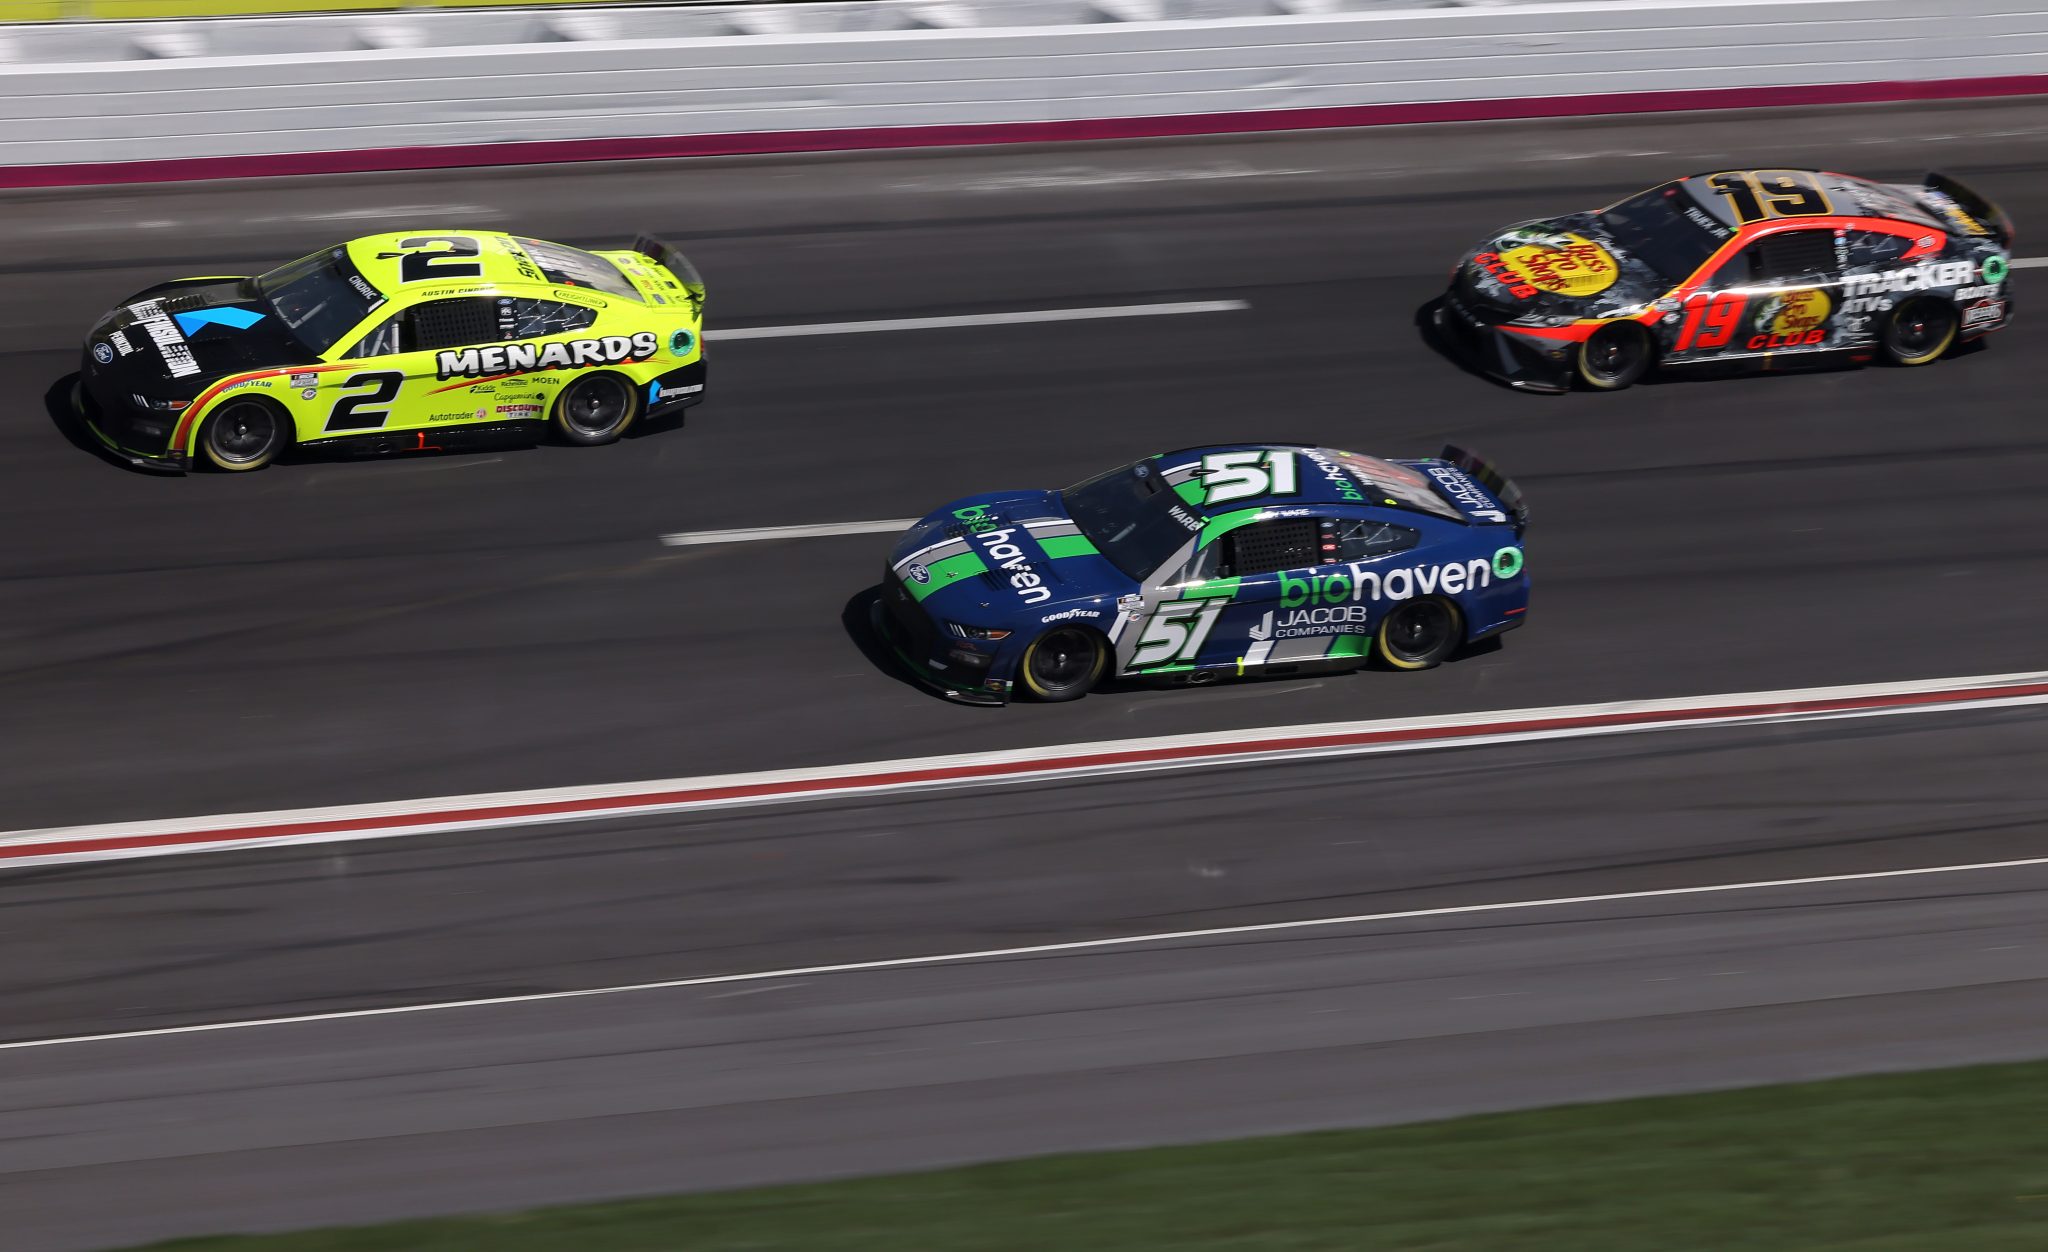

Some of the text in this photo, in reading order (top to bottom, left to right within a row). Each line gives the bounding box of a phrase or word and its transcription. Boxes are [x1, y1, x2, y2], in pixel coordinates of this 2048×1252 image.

[1706, 170, 1834, 225] 19
[1684, 206, 1717, 231] TRUEX
[400, 236, 482, 284] 2
[1543, 249, 1581, 271] Pro
[1566, 244, 1612, 273] Bass
[1473, 252, 1539, 299] CLUB
[1516, 254, 1570, 292] Shops
[1840, 261, 1975, 297] TRACKER
[349, 275, 378, 300] CINDRIC
[1673, 292, 1749, 352] 19
[108, 330, 134, 356] PENNZOIL
[1746, 329, 1827, 349] CLUB
[437, 333, 657, 379] MENARDS
[532, 377, 560, 385] MOEN
[323, 370, 404, 433] 2
[494, 392, 535, 403] Capgemini
[496, 404, 544, 413] DISCOUNT
[429, 411, 474, 422] Autotrader
[1202, 450, 1296, 505] 51
[1428, 467, 1483, 509] JACOB
[1168, 505, 1201, 531] WARE
[909, 564, 928, 583] Ford
[1277, 558, 1490, 609] biohaven
[1041, 608, 1101, 623] GOODYEAR
[1277, 606, 1367, 627] JACOB
[1128, 597, 1231, 668] 51
[1275, 624, 1366, 638] COMPANIES
